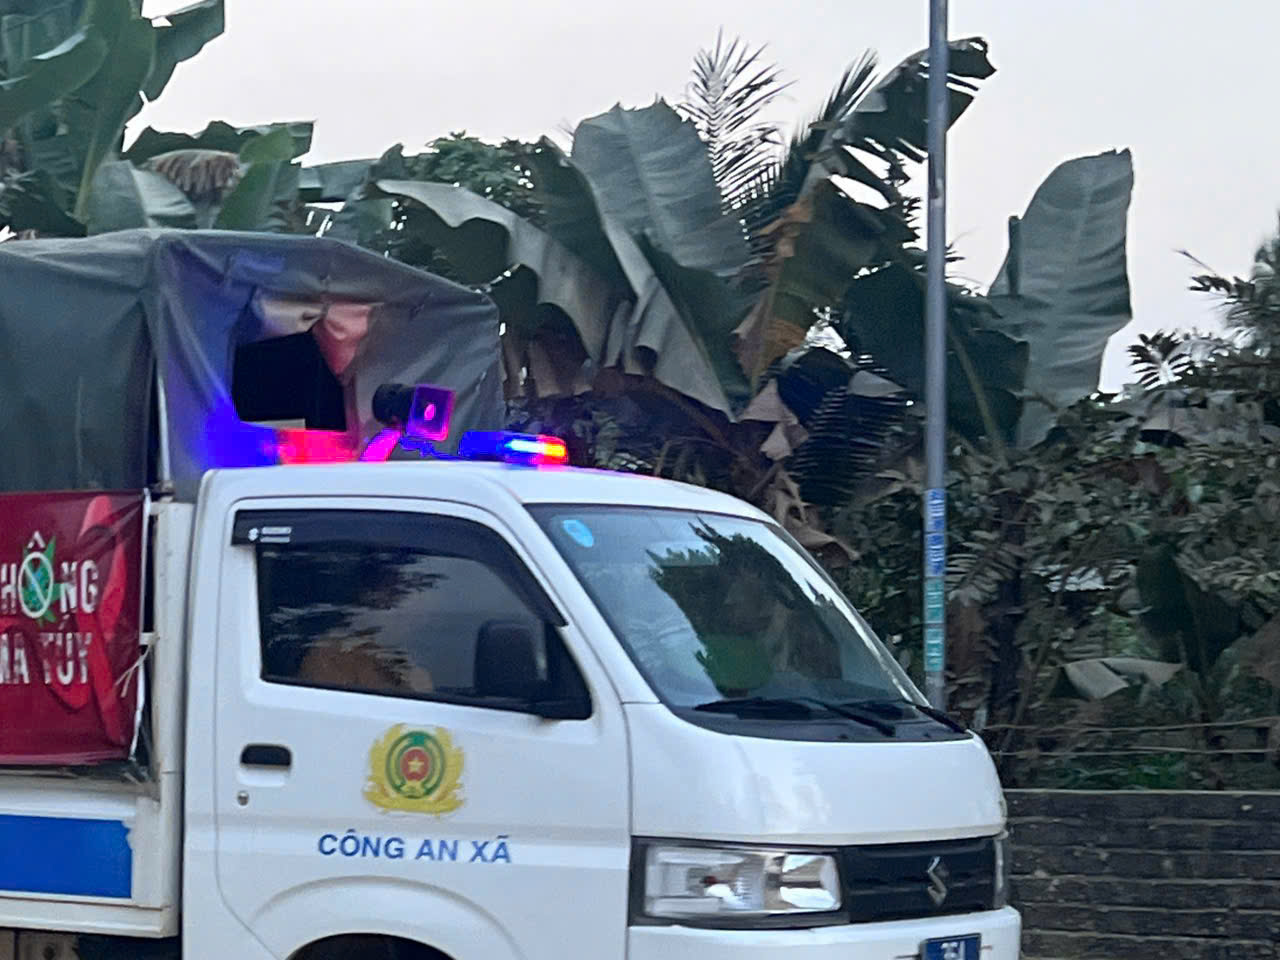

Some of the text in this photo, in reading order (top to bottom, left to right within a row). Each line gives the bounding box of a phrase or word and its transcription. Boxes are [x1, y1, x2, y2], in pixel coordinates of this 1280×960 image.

[40, 614, 93, 686] TÚY
[317, 828, 512, 864] CÔNG AN XÃ
